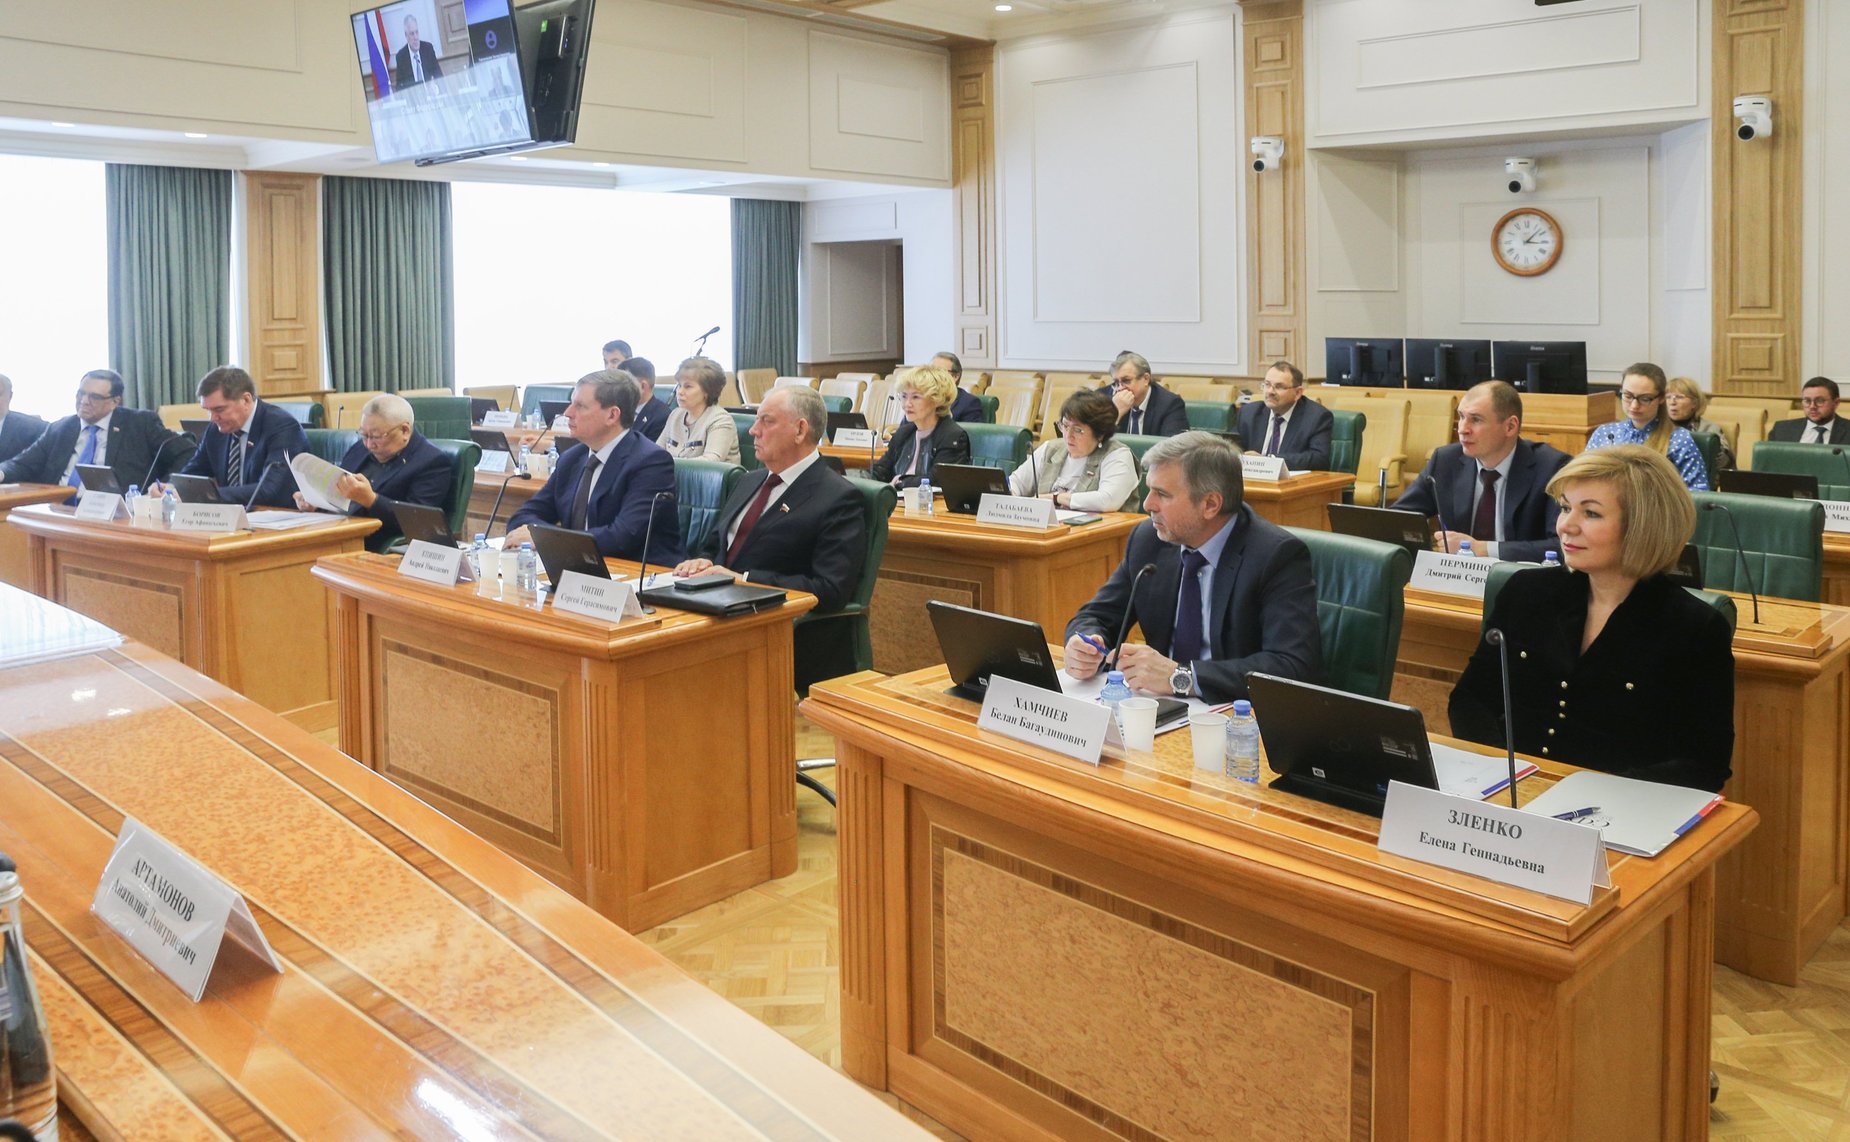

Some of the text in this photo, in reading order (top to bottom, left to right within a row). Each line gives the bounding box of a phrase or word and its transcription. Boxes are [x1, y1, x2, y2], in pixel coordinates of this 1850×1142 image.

[1425, 568, 1462, 580] Дмитрий
[560, 592, 618, 613] Сергей Герасимович
[581, 584, 605, 597] МИТИН
[990, 707, 1017, 725] Белан
[1013, 697, 1068, 723] ХАМЧИЕВ
[1447, 809, 1523, 840] ЗЛЕНКО
[1419, 831, 1545, 874] Елена Геннадьевна
[131, 858, 195, 922] АРТАМОНОВ
[111, 877, 197, 966] Анатолий Дмитриевич
